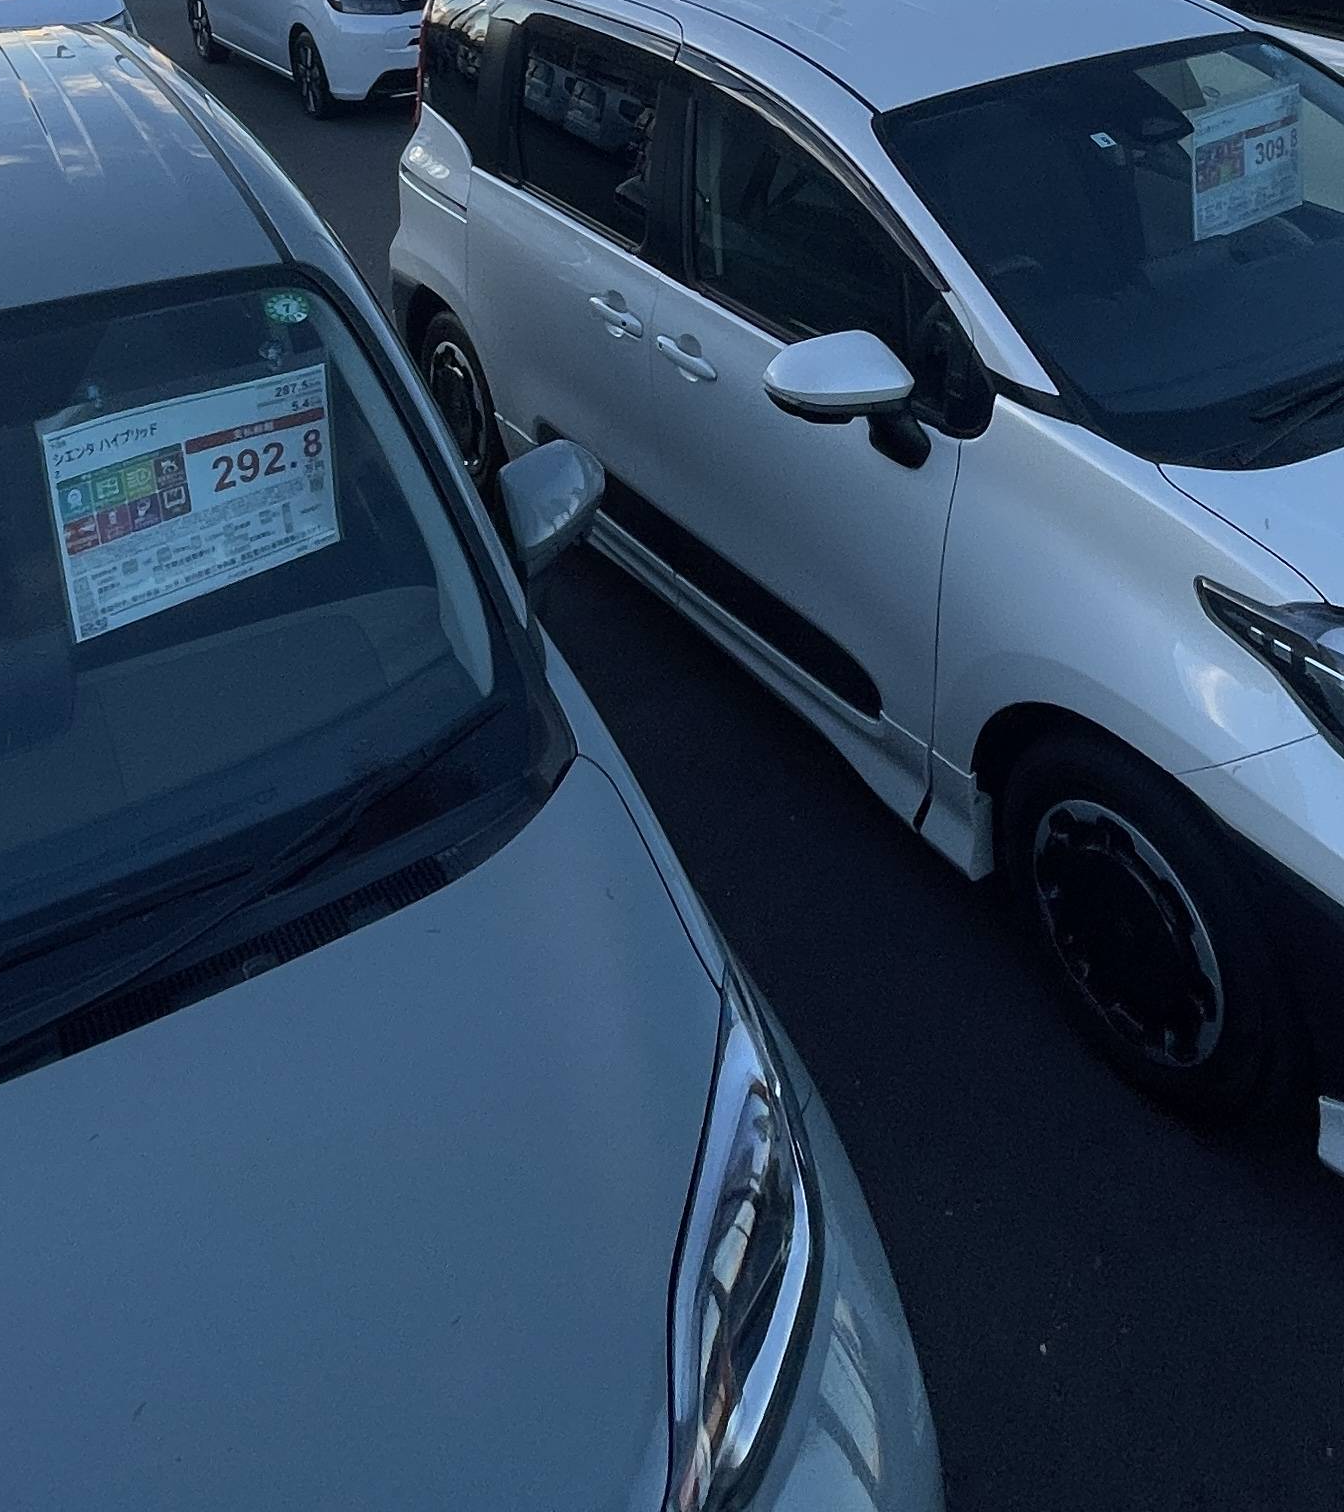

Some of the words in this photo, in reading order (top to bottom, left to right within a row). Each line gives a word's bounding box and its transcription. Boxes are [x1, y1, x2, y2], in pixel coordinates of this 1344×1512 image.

[52, 441, 95, 467] シエンタ
[212, 429, 323, 492] 292.8
